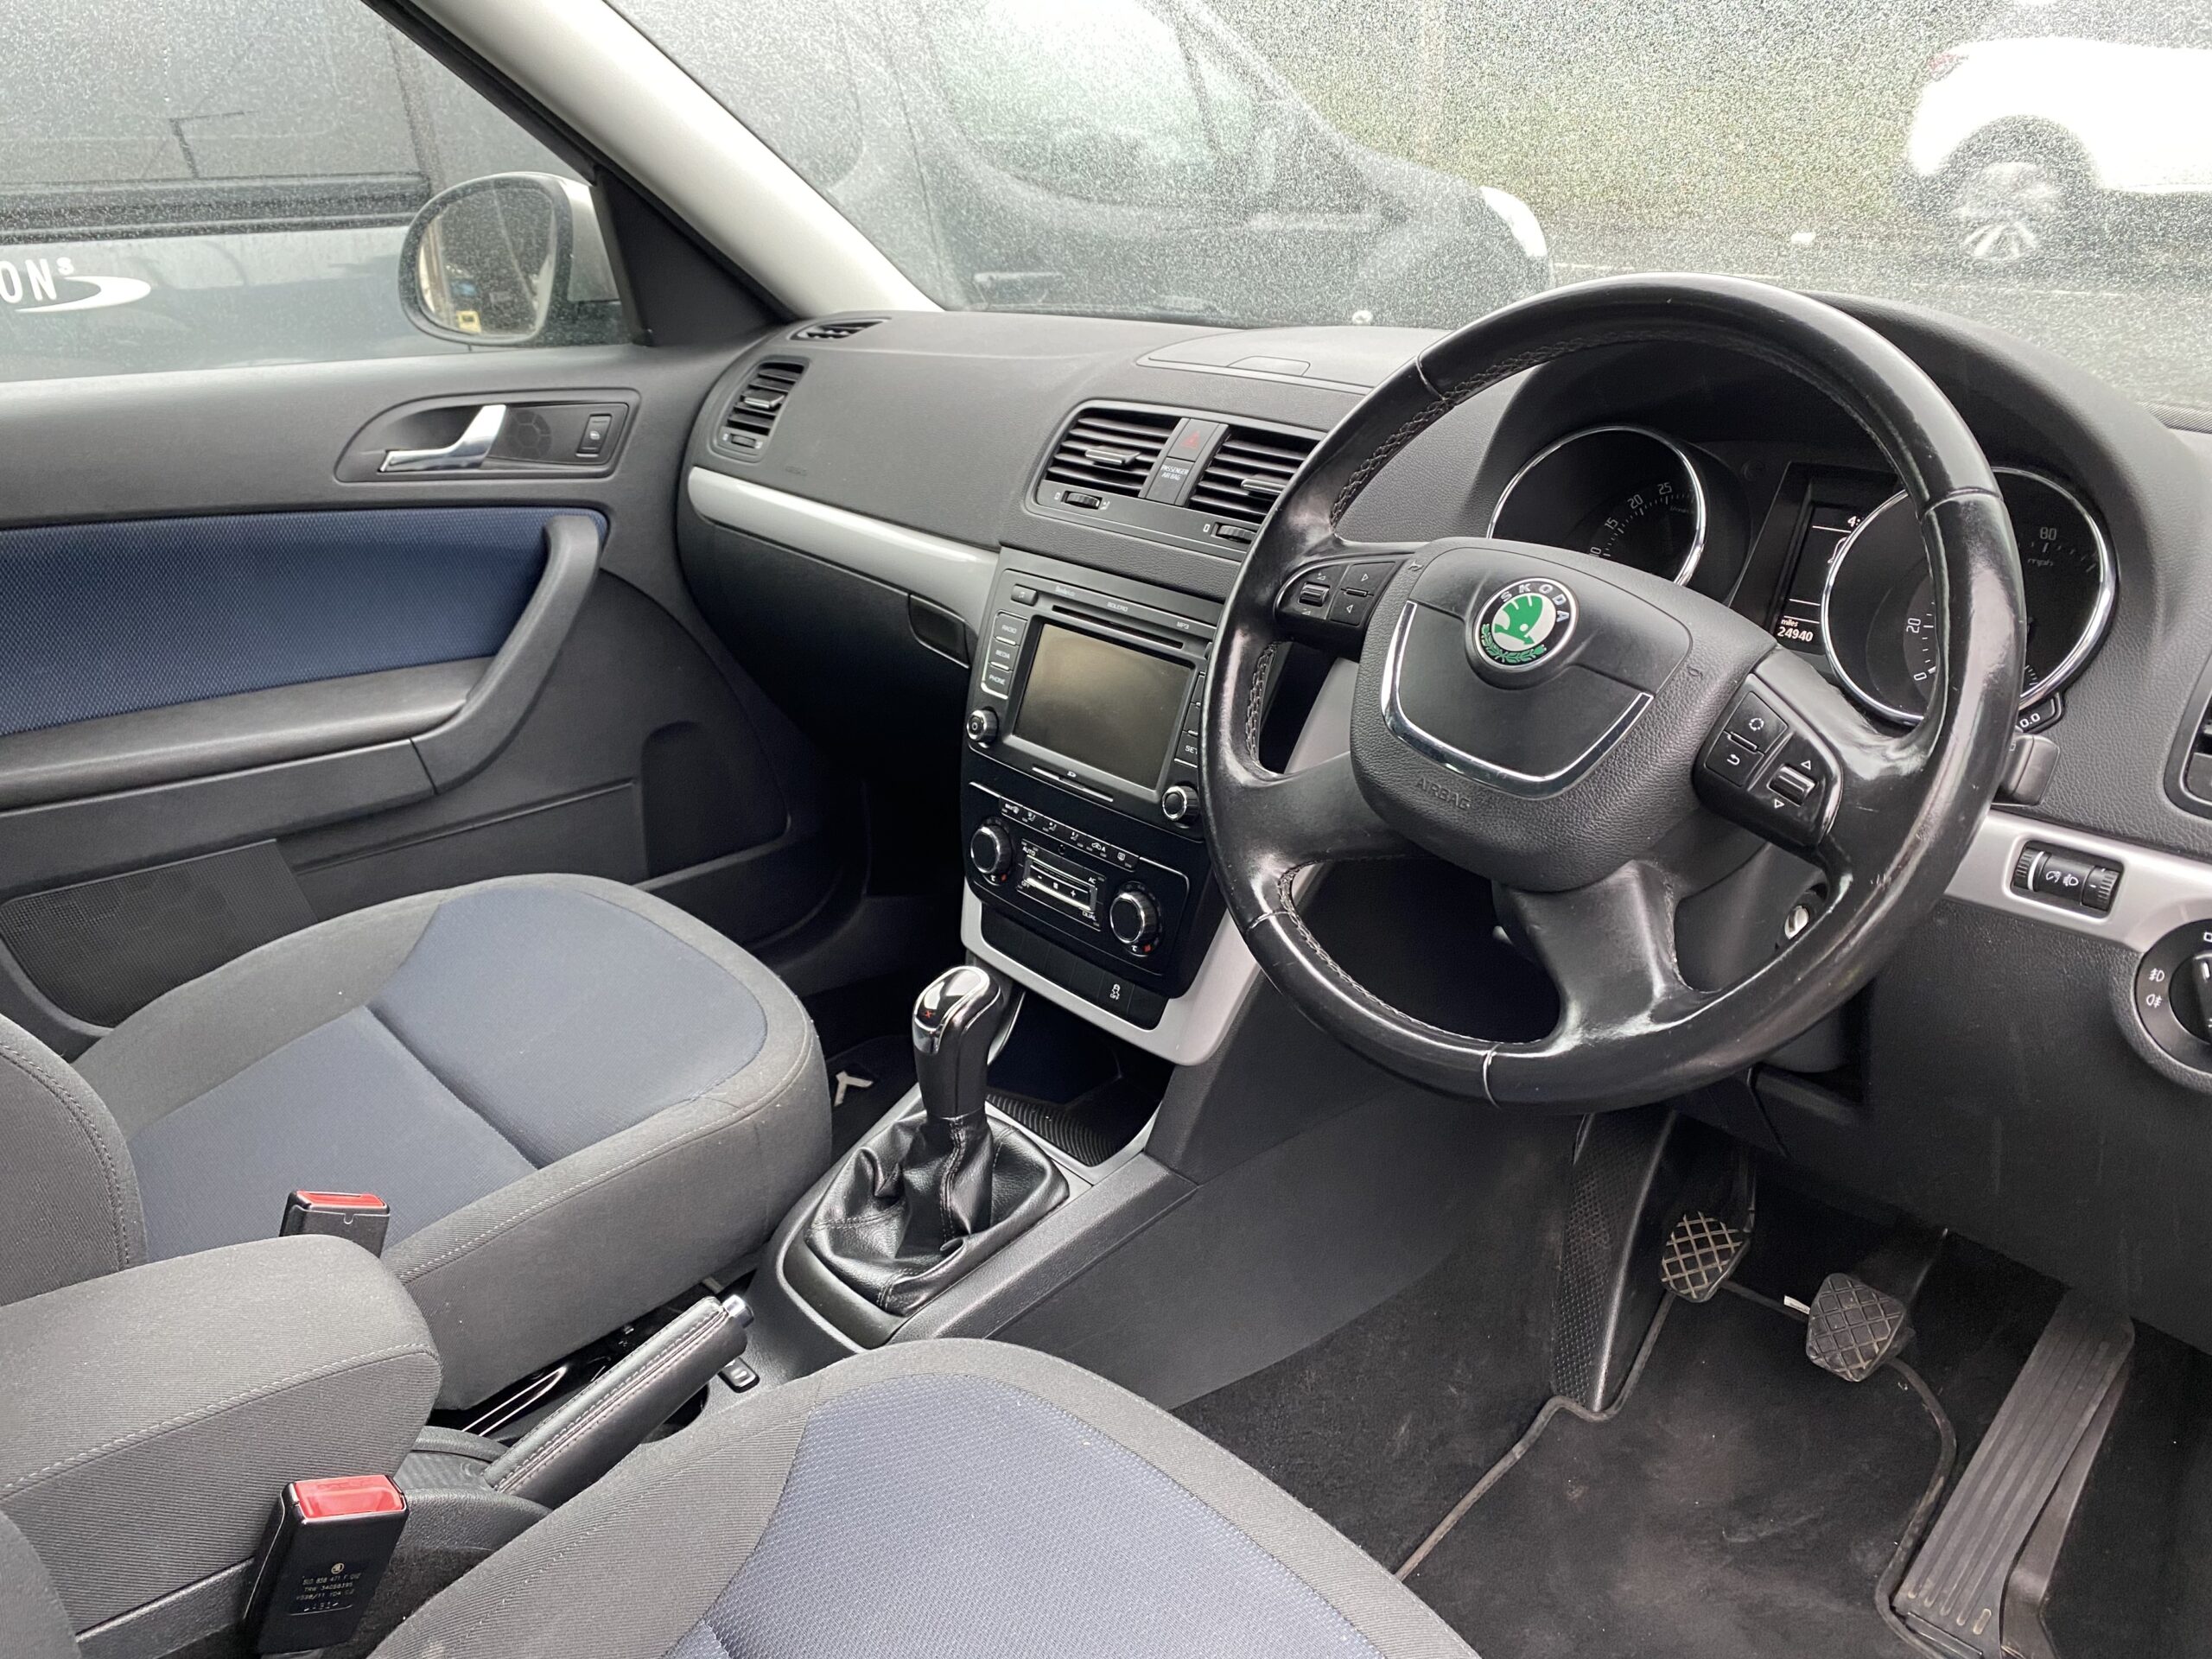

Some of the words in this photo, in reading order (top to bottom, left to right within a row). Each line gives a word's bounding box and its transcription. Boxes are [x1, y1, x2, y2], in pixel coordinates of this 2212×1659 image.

[1657, 482, 1673, 495] 25
[1627, 493, 1643, 510] 20
[1604, 518, 1618, 530] 15
[2040, 526, 2057, 541] 80
[1500, 582, 1570, 623] SKODA
[1176, 621, 1190, 630] MP3
[1781, 619, 1799, 627] miles
[1905, 617, 1922, 633] 20
[1777, 626, 1814, 642] 24940
[1417, 778, 1471, 810] AIRBAG
[1022, 846, 1036, 856] AUTO
